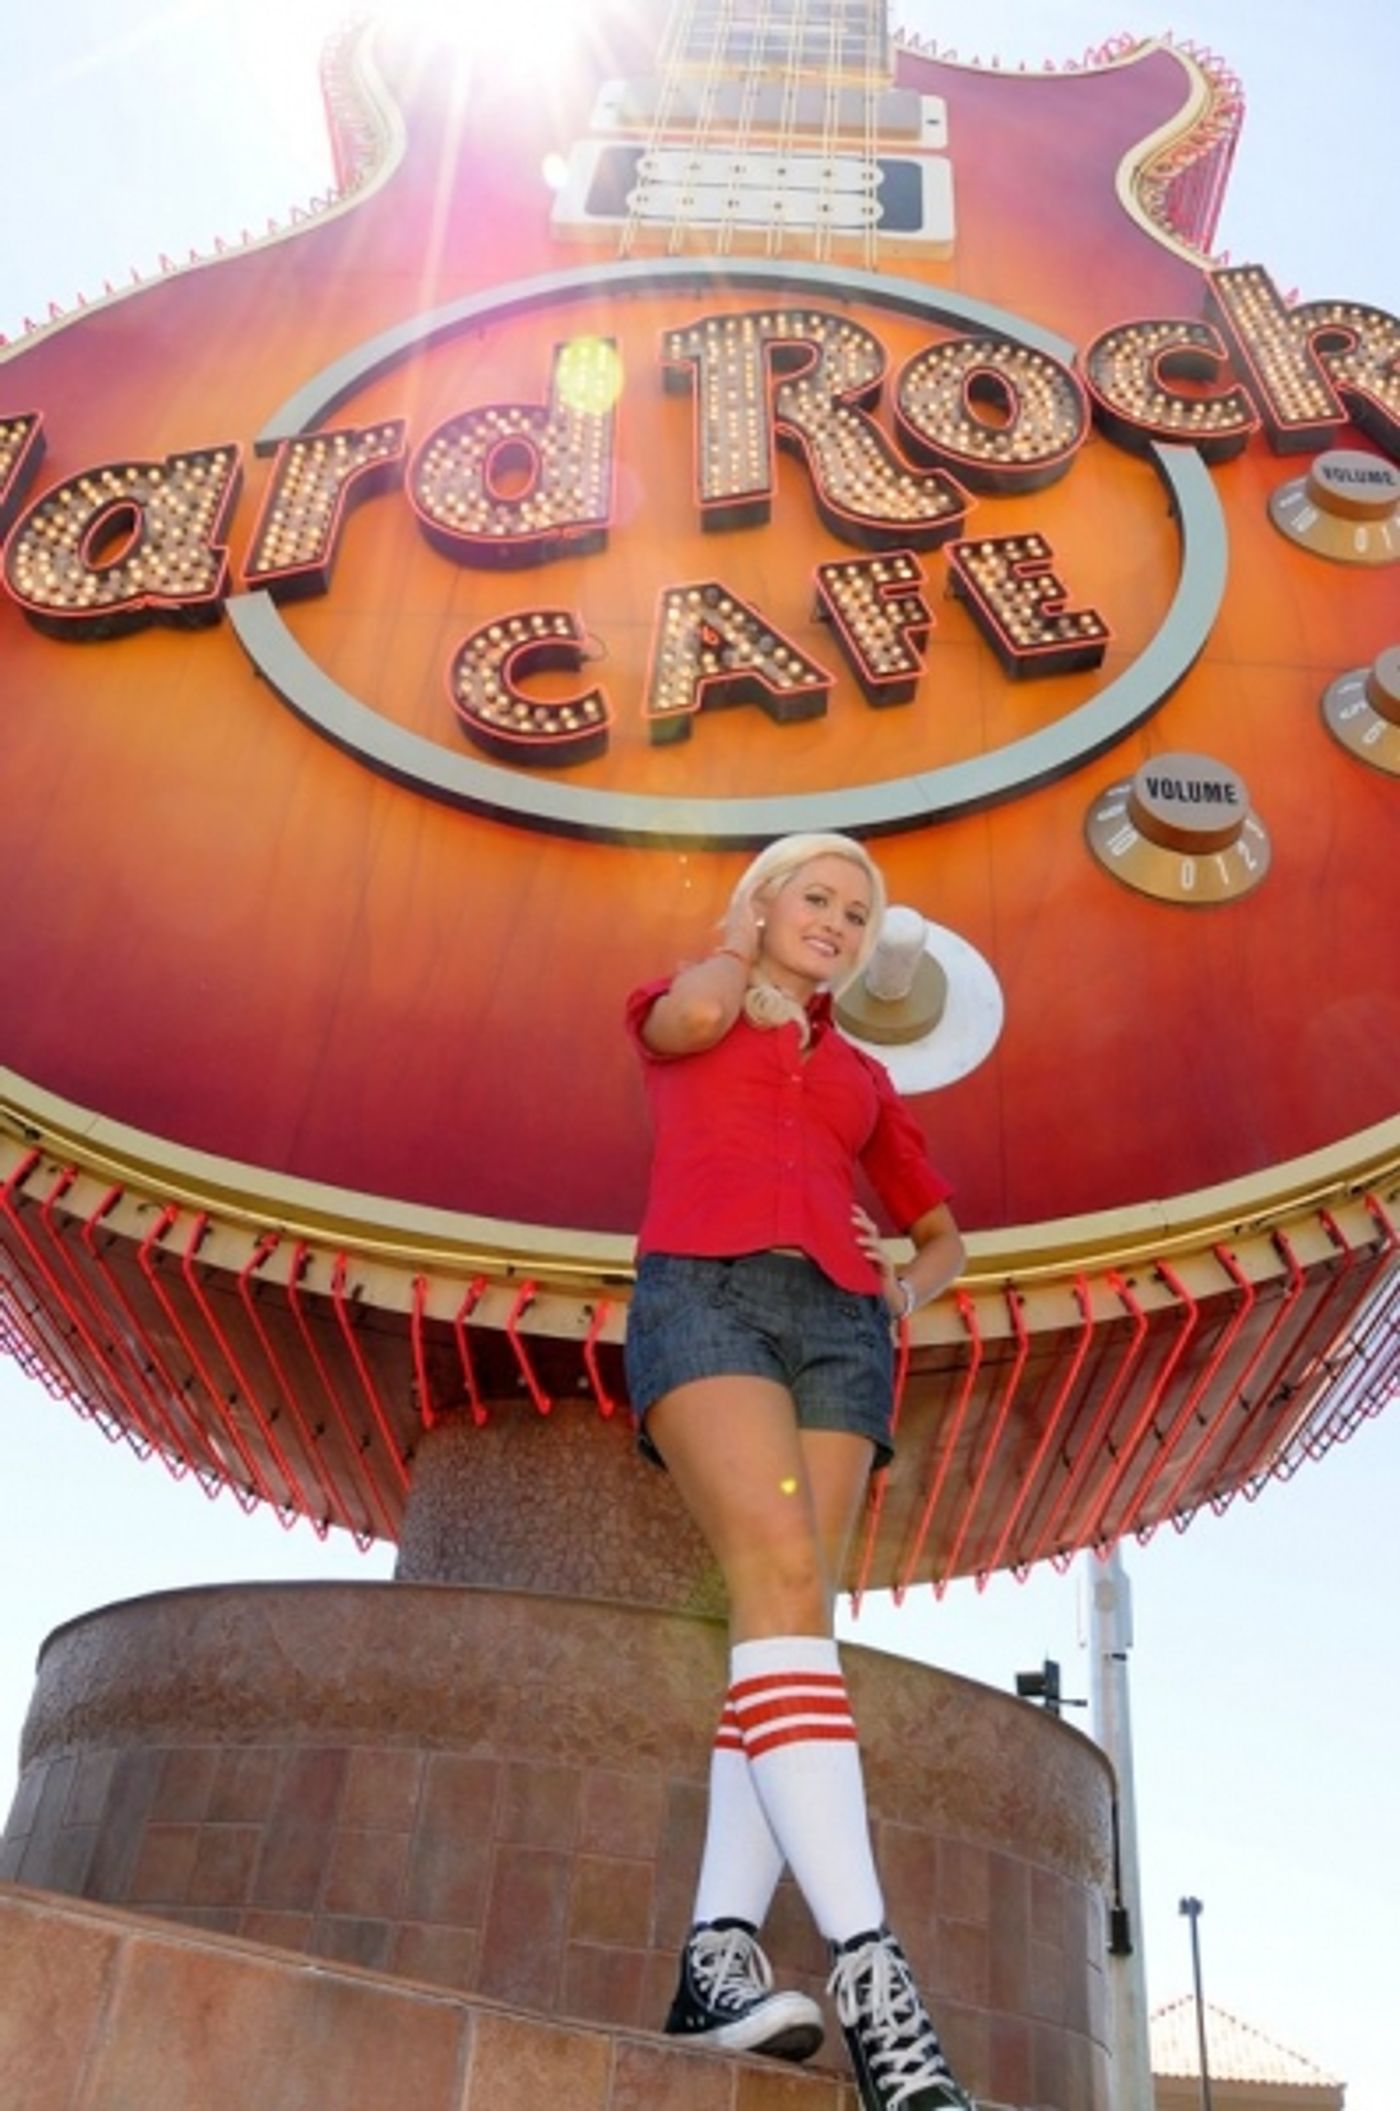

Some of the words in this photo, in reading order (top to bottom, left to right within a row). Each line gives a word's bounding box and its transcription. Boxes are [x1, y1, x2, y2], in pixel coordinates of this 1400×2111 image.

[0, 338, 626, 640] ard
[1321, 465, 1397, 487] VOLUME
[444, 533, 1117, 768] CAFE
[1145, 776, 1240, 806] VOLUME
[1180, 857, 1196, 891] 0
[1214, 855, 1230, 885] 1
[1236, 839, 1258, 872] 2
